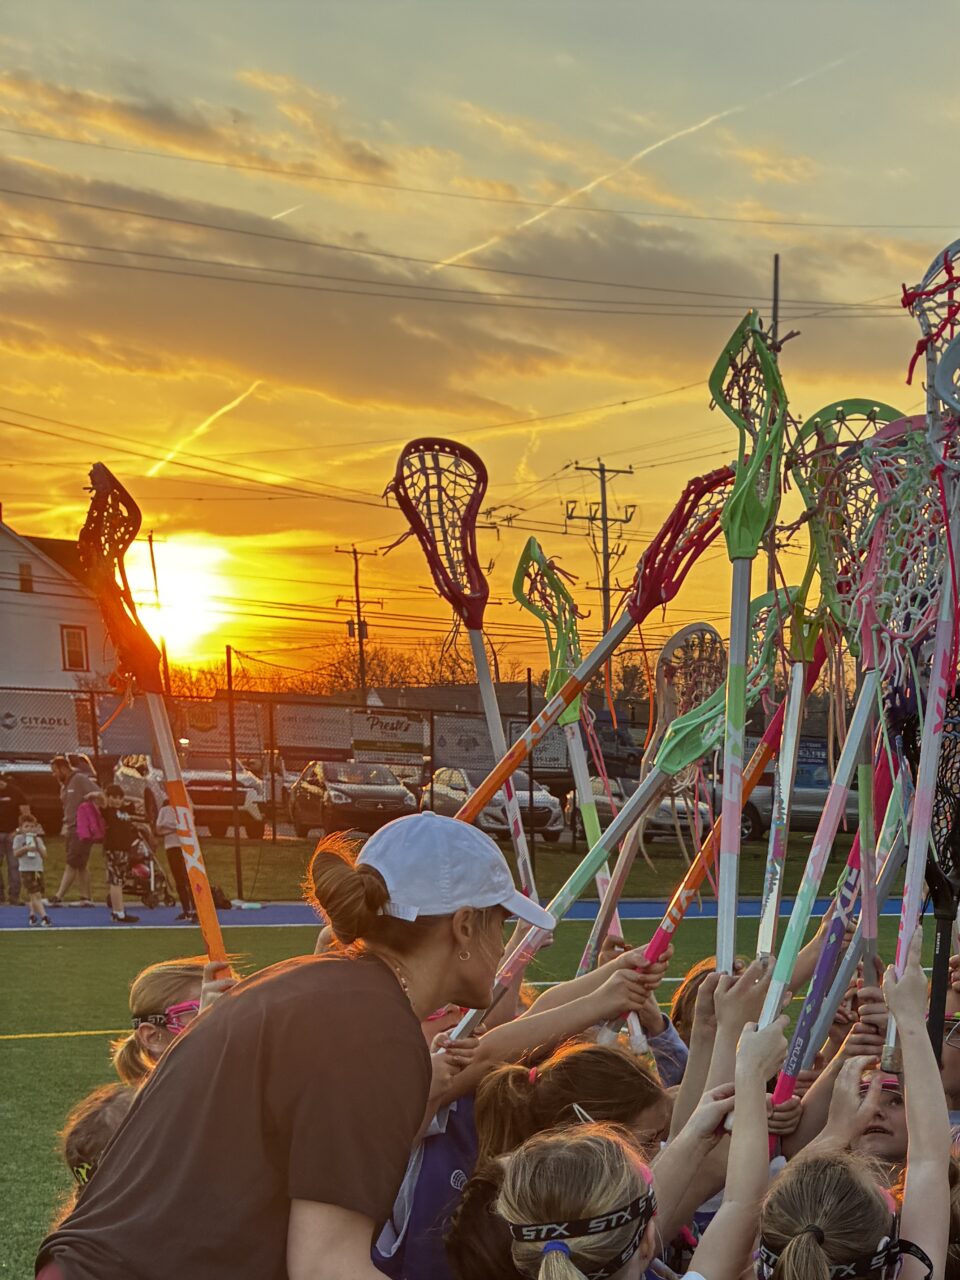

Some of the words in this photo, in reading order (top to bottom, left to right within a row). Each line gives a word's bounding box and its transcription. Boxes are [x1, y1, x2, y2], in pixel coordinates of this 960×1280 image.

[20, 716, 70, 726] CITADEL
[174, 806, 206, 875] STX
[588, 1207, 632, 1233] STX
[522, 1222, 570, 1240] STX
[829, 1263, 857, 1277] TX
